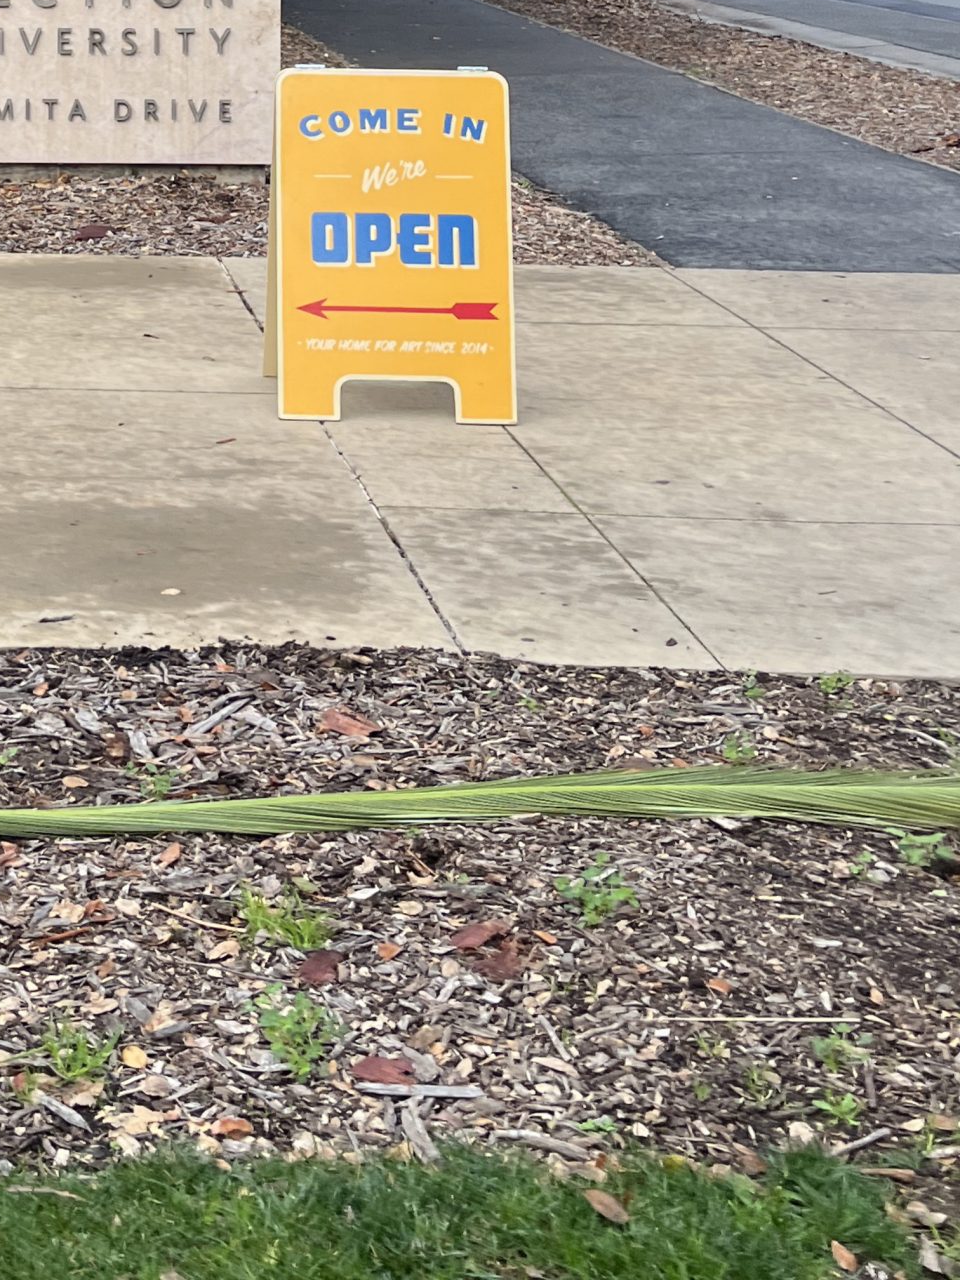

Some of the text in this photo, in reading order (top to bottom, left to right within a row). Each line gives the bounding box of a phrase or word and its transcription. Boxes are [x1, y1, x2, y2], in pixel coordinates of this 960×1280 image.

[113, 98, 232, 122] DRIVE
[299, 108, 488, 144] COME IN
[361, 159, 427, 193] We're
[311, 212, 480, 269] OPEN
[305, 337, 489, 356] YOUR HOME FOR ART SINCE 2014
